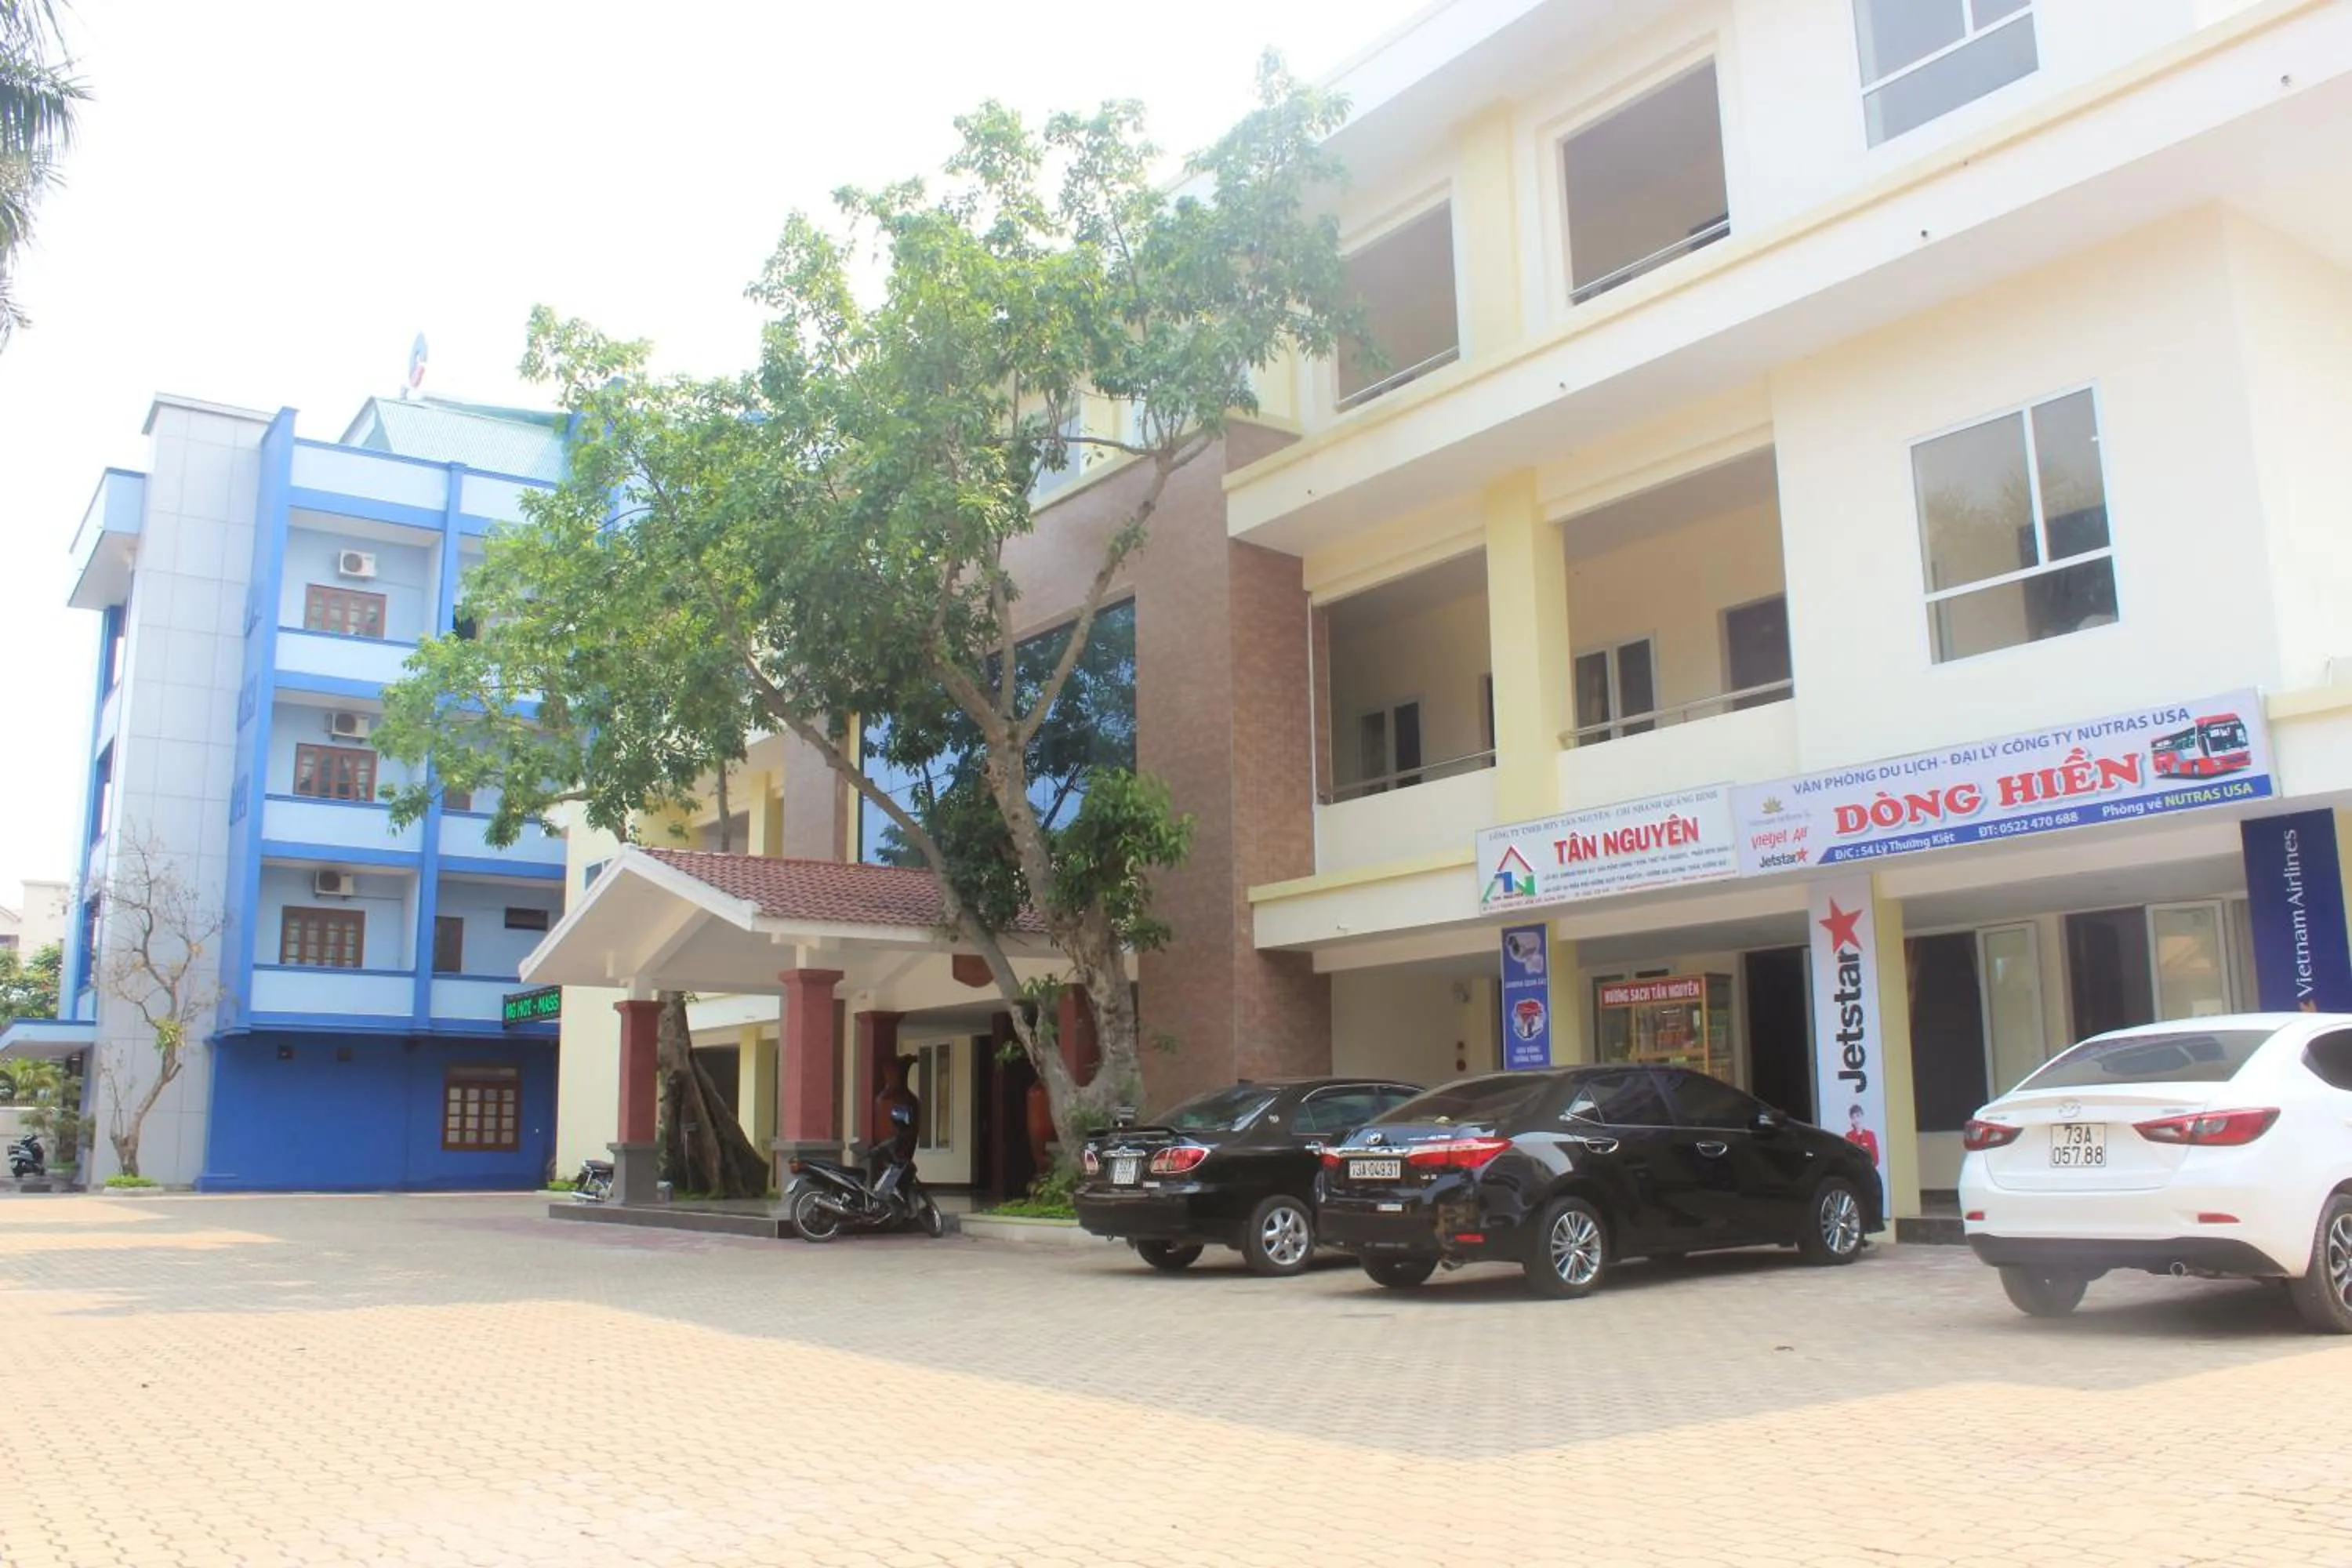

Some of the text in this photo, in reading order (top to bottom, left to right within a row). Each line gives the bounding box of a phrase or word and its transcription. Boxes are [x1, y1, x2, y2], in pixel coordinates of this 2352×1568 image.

[1880, 764, 1900, 779] DU
[1904, 757, 1937, 775] LỊCH
[2002, 735, 2049, 755] CÔNG
[2054, 730, 2072, 745] TY
[2078, 715, 2148, 740] NUTRAS
[2152, 708, 2190, 725] USA
[1554, 831, 1597, 865] TÂN
[1603, 813, 1699, 856] NGUYÊN
[1861, 844, 1874, 855] 54
[1999, 819, 2029, 833] 0522
[2031, 815, 2053, 828] 470
[2102, 801, 2144, 817] Phòng
[2165, 788, 2221, 807] NUTRAS
[2223, 782, 2254, 798] USA
[2283, 828, 2314, 998] Vietnam Airlines
[1834, 947, 1867, 1094] Jetstar
[2053, 1145, 2103, 1164] 057.88
[2063, 1126, 2092, 1144] 73A
